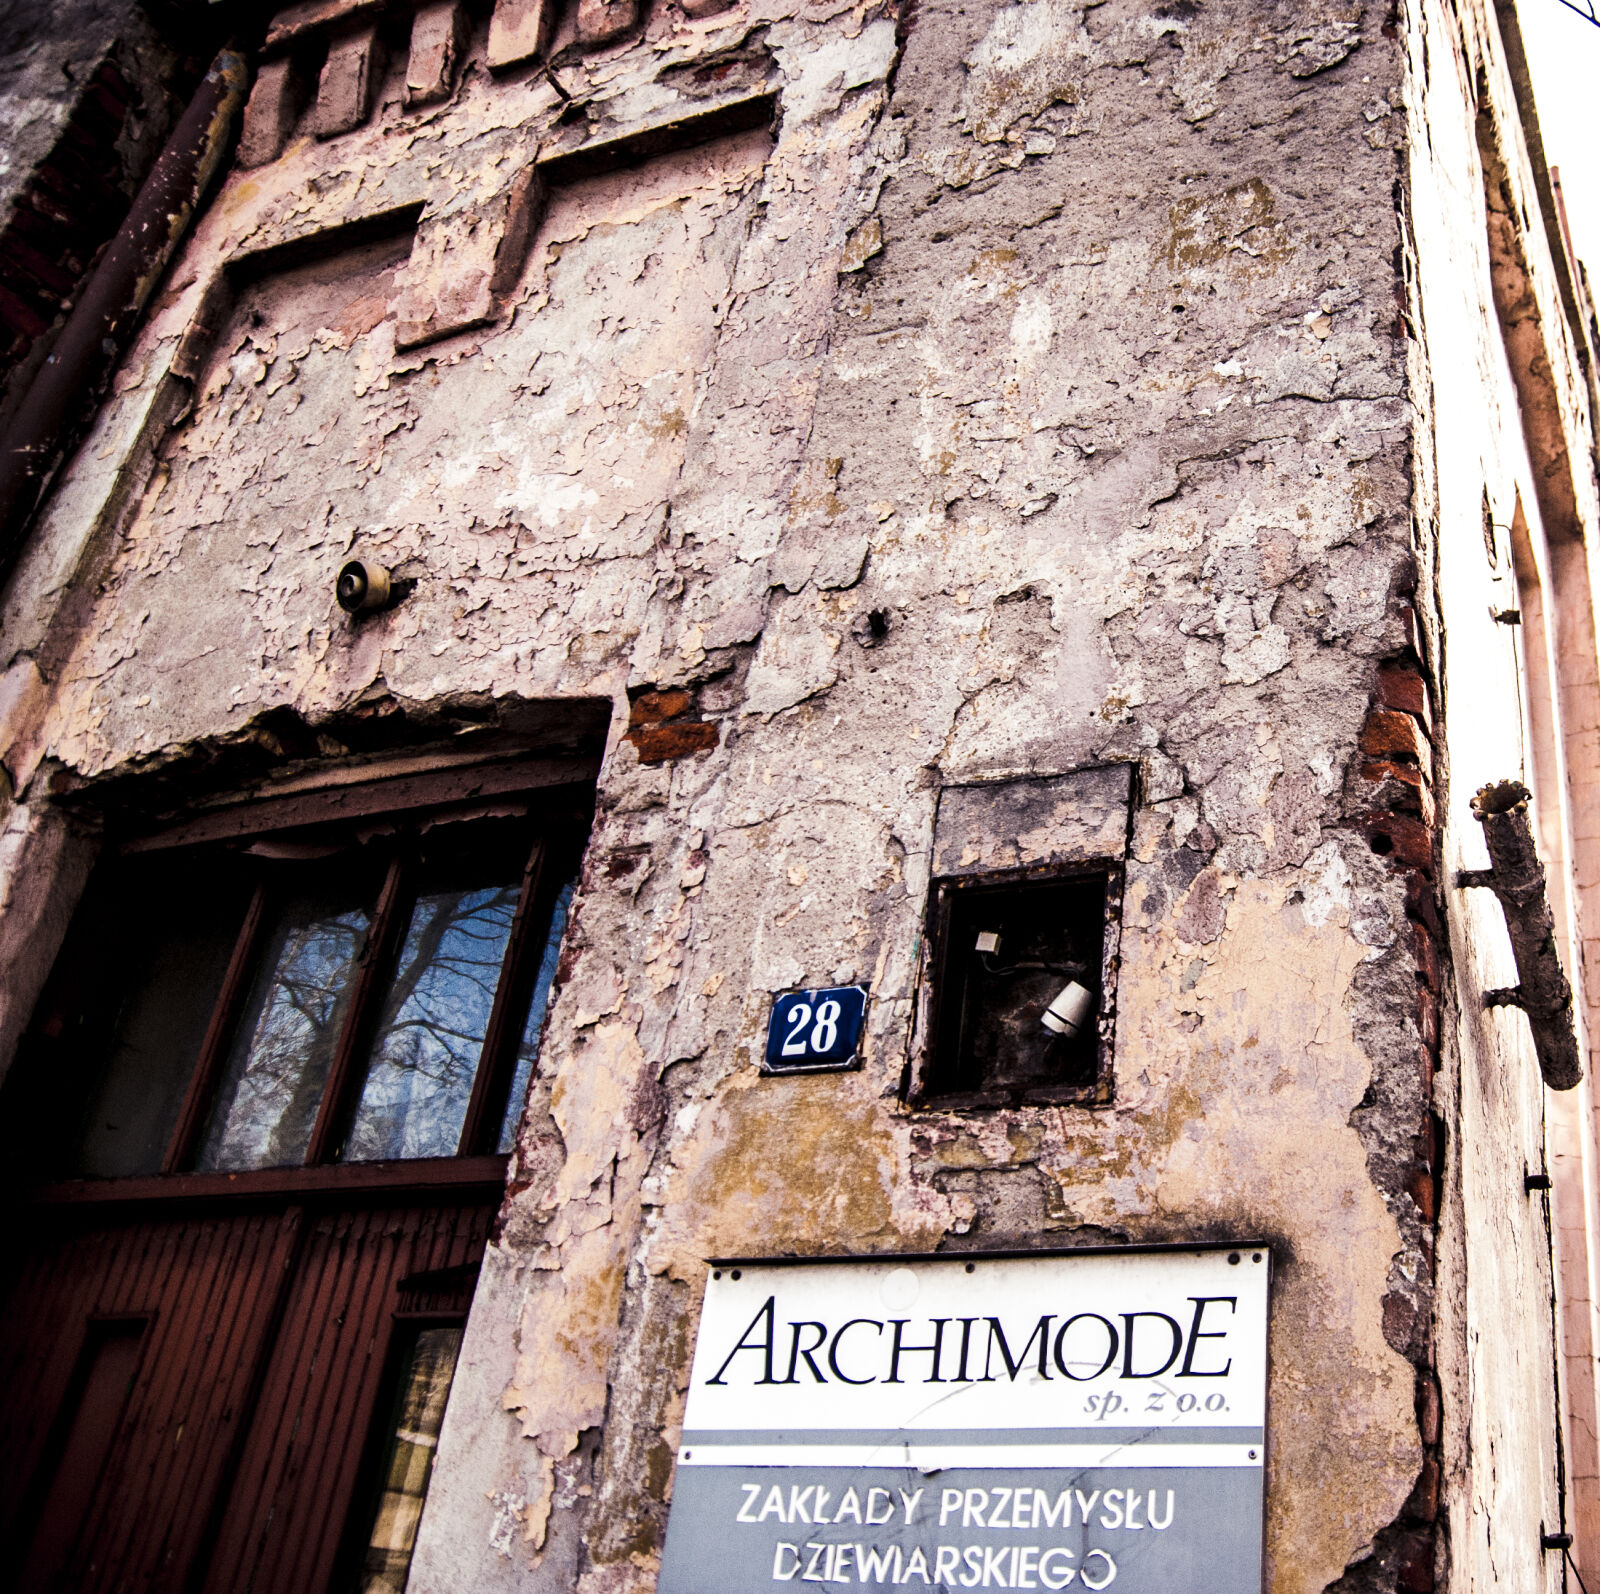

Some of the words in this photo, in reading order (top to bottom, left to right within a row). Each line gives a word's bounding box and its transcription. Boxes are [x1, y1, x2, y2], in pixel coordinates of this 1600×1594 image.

[781, 1000, 841, 1056] 28
[705, 1295, 1238, 1386] ARCHIMODE
[1083, 1391, 1129, 1421] sp.
[1144, 1391, 1165, 1413] z
[1175, 1390, 1231, 1414] o.o.
[736, 1483, 922, 1527] ZAKŁADY
[939, 1487, 1176, 1530] PRZEMYSŁU
[772, 1541, 1118, 1591] DZIEWIARSKIEGO
